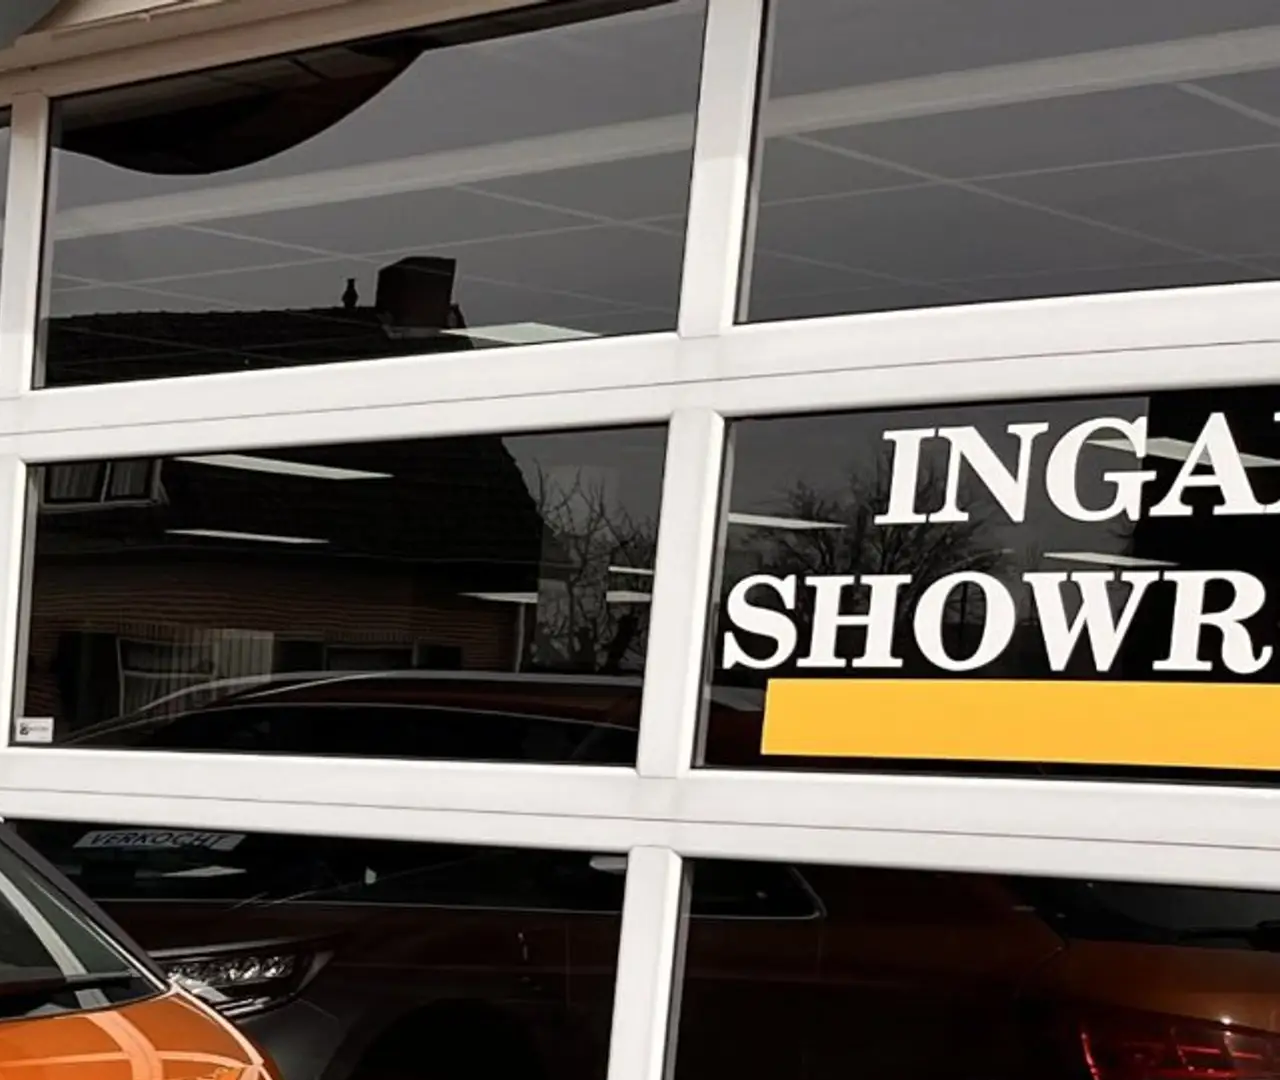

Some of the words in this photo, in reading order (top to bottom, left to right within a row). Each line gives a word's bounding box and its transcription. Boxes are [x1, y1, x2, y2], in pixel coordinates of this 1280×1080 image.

[874, 411, 1280, 524] INGA
[722, 570, 1273, 674] SHOWR
[91, 831, 230, 849] VERKOCHT
